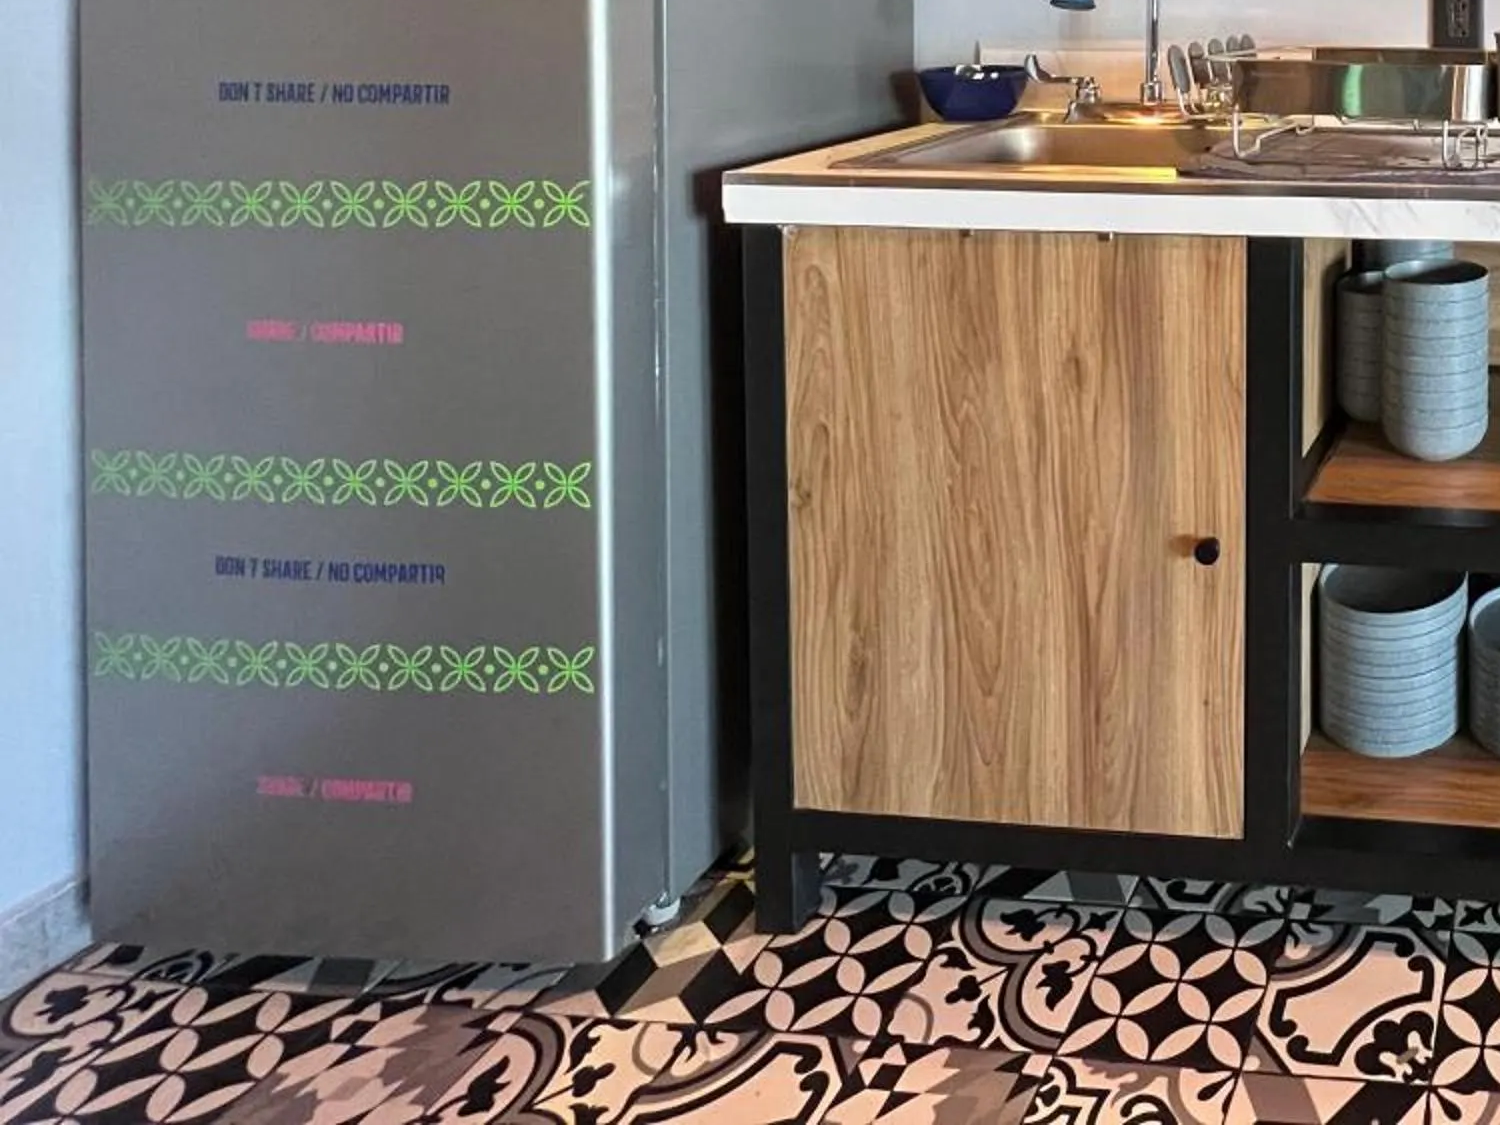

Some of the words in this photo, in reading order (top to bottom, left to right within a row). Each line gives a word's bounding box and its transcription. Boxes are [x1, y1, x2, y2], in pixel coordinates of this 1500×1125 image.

[265, 81, 315, 103] SHARE
[332, 83, 354, 104] NO
[358, 83, 450, 105] COMPARTIR
[262, 559, 312, 581] SHARE
[328, 561, 350, 583] NO
[353, 562, 445, 585] COMPARTIR
